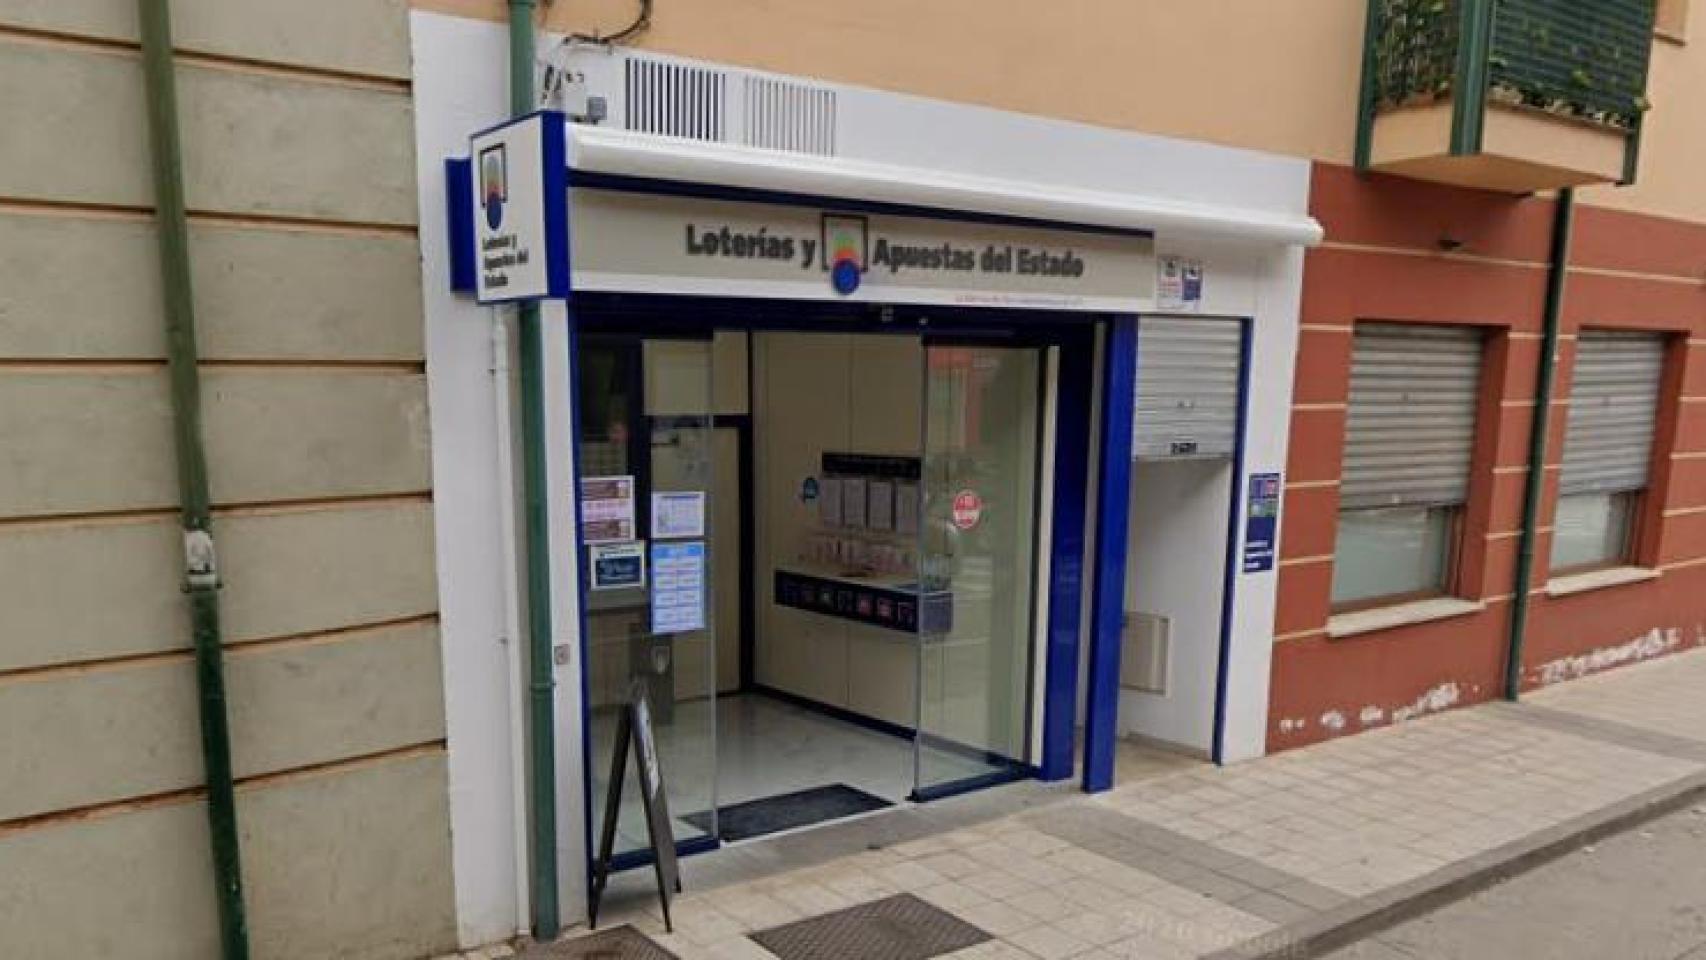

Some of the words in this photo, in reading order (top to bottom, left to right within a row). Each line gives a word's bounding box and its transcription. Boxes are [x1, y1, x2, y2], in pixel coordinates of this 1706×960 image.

[686, 224, 795, 260] Loterías
[801, 239, 816, 270] y
[873, 238, 976, 273] Apuestas
[981, 243, 1013, 274] del
[1016, 249, 1084, 278] Estado
